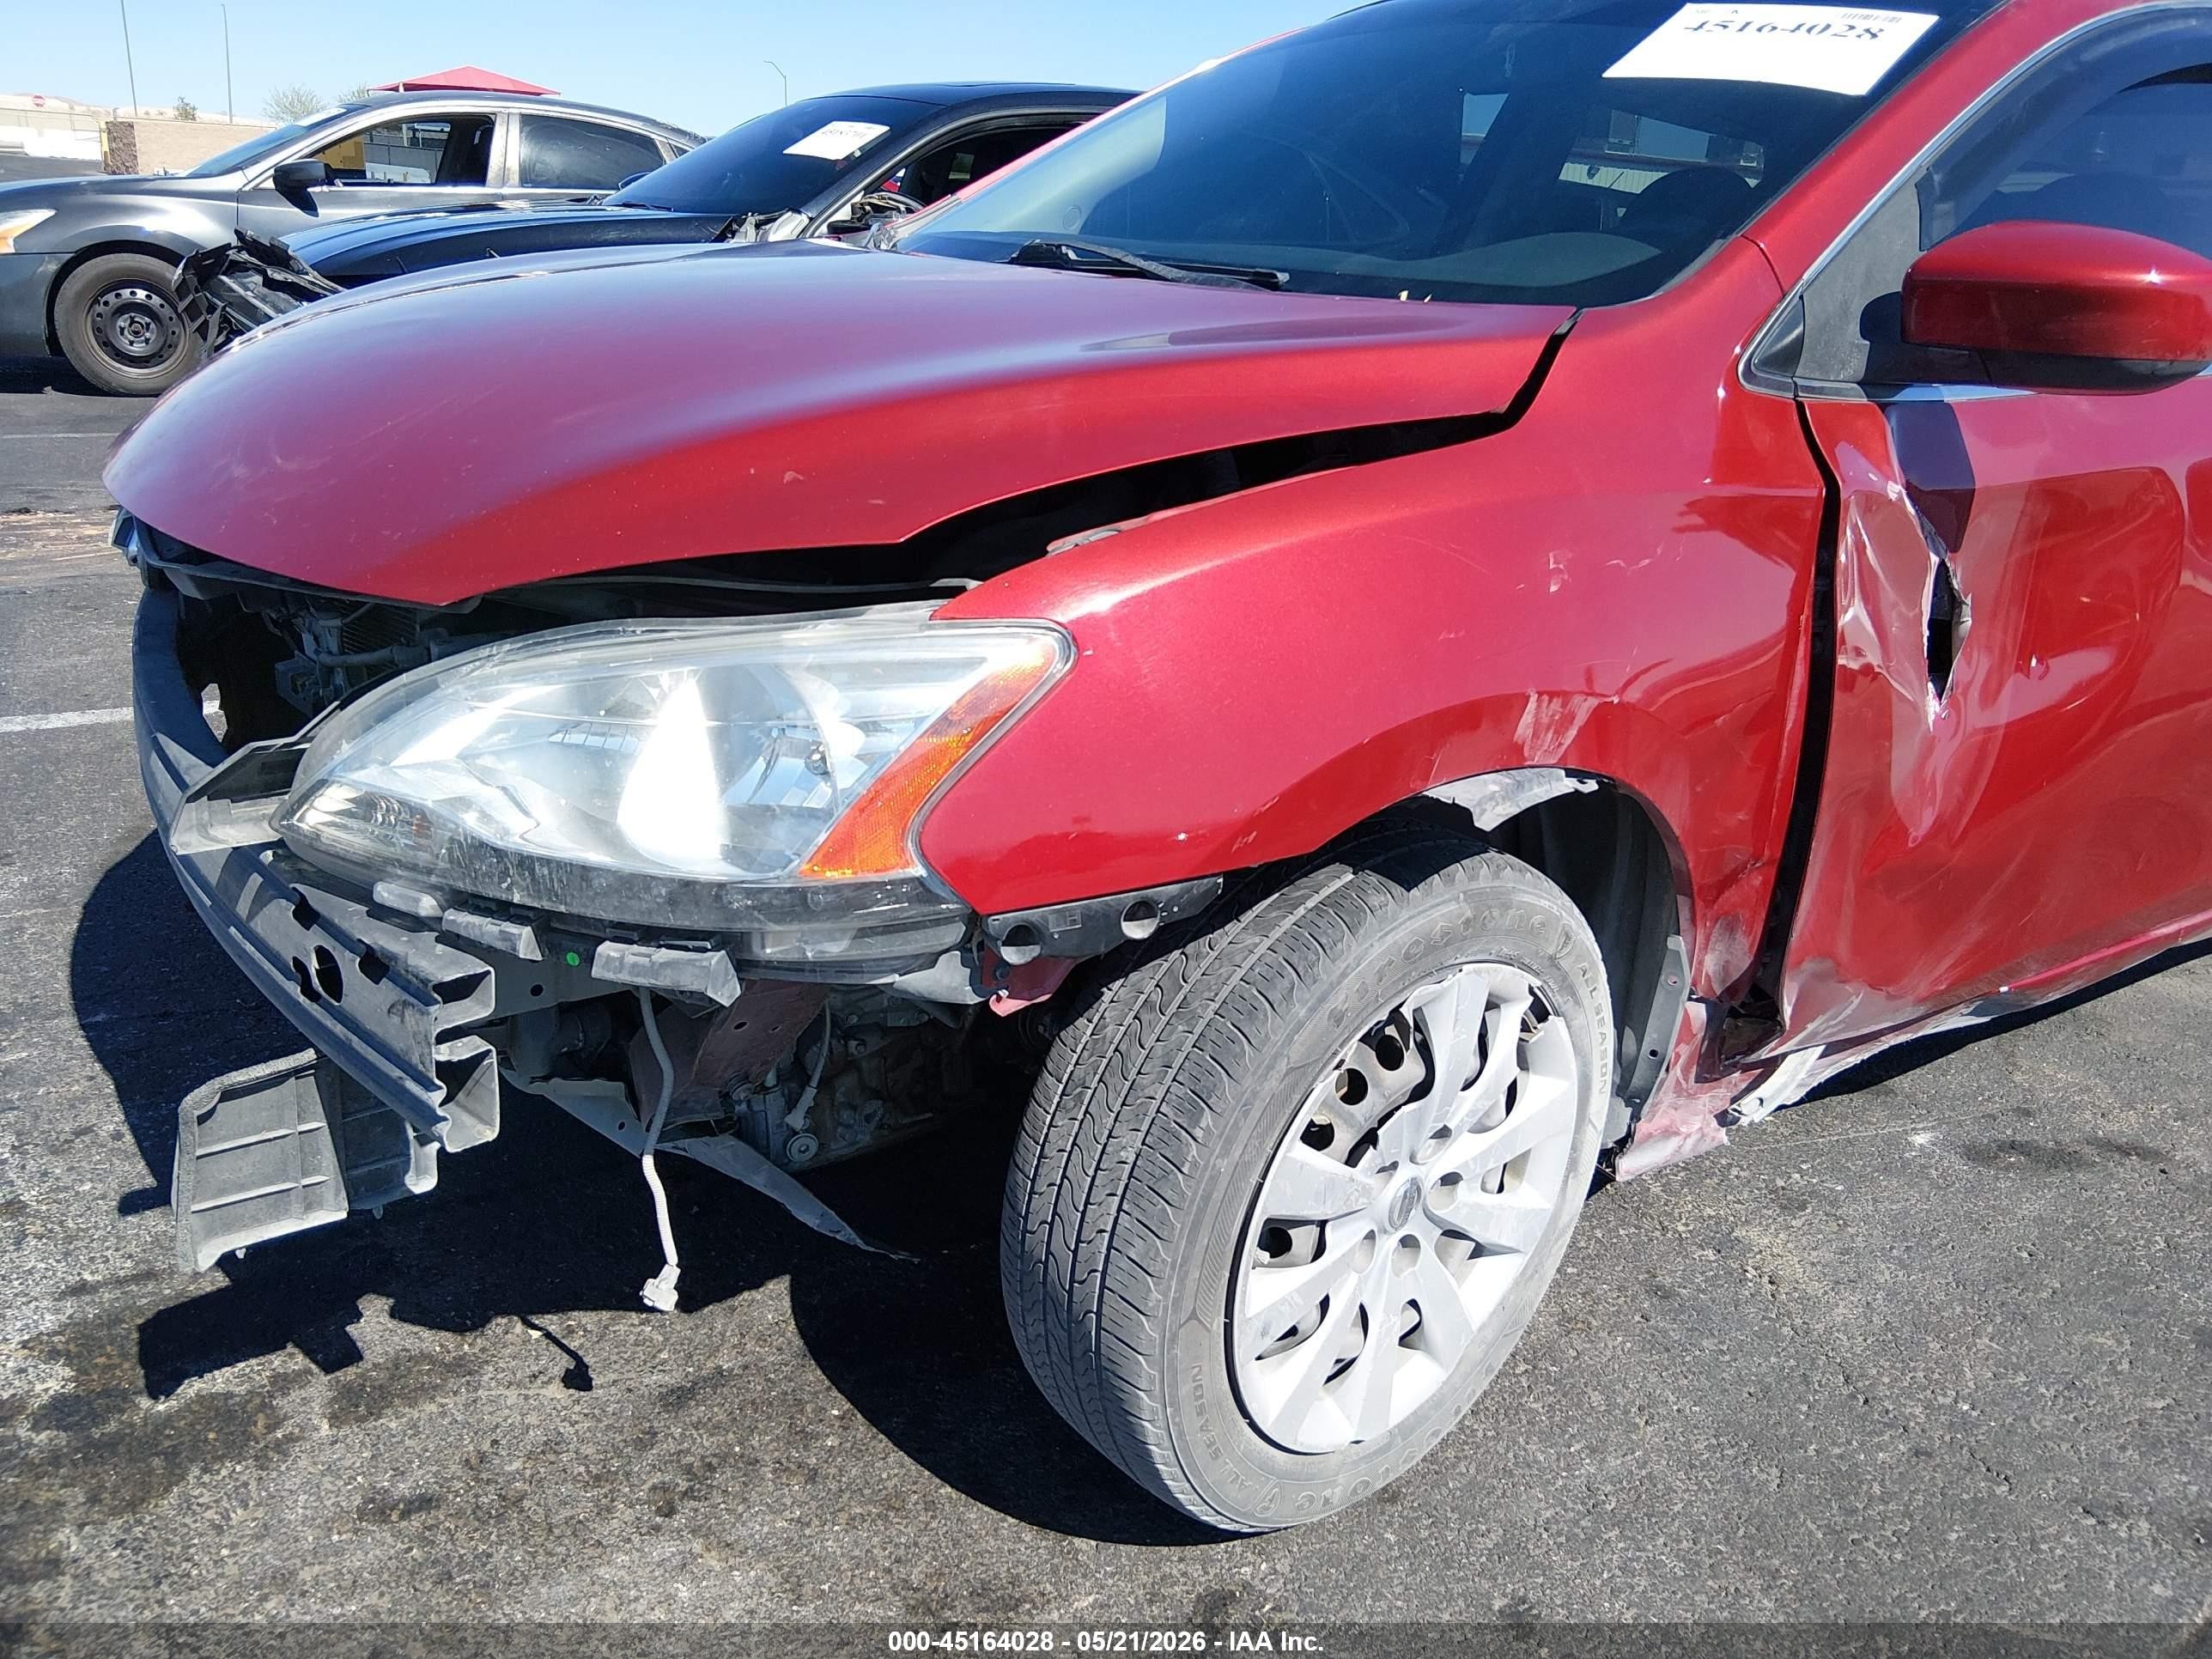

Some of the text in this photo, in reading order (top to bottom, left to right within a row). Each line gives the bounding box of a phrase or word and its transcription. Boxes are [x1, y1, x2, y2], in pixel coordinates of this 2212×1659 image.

[1683, 20, 1885, 40] 45164028
[1577, 962, 1611, 1096] ALL SEASON
[1191, 1362, 1253, 1492] ALL SEASON
